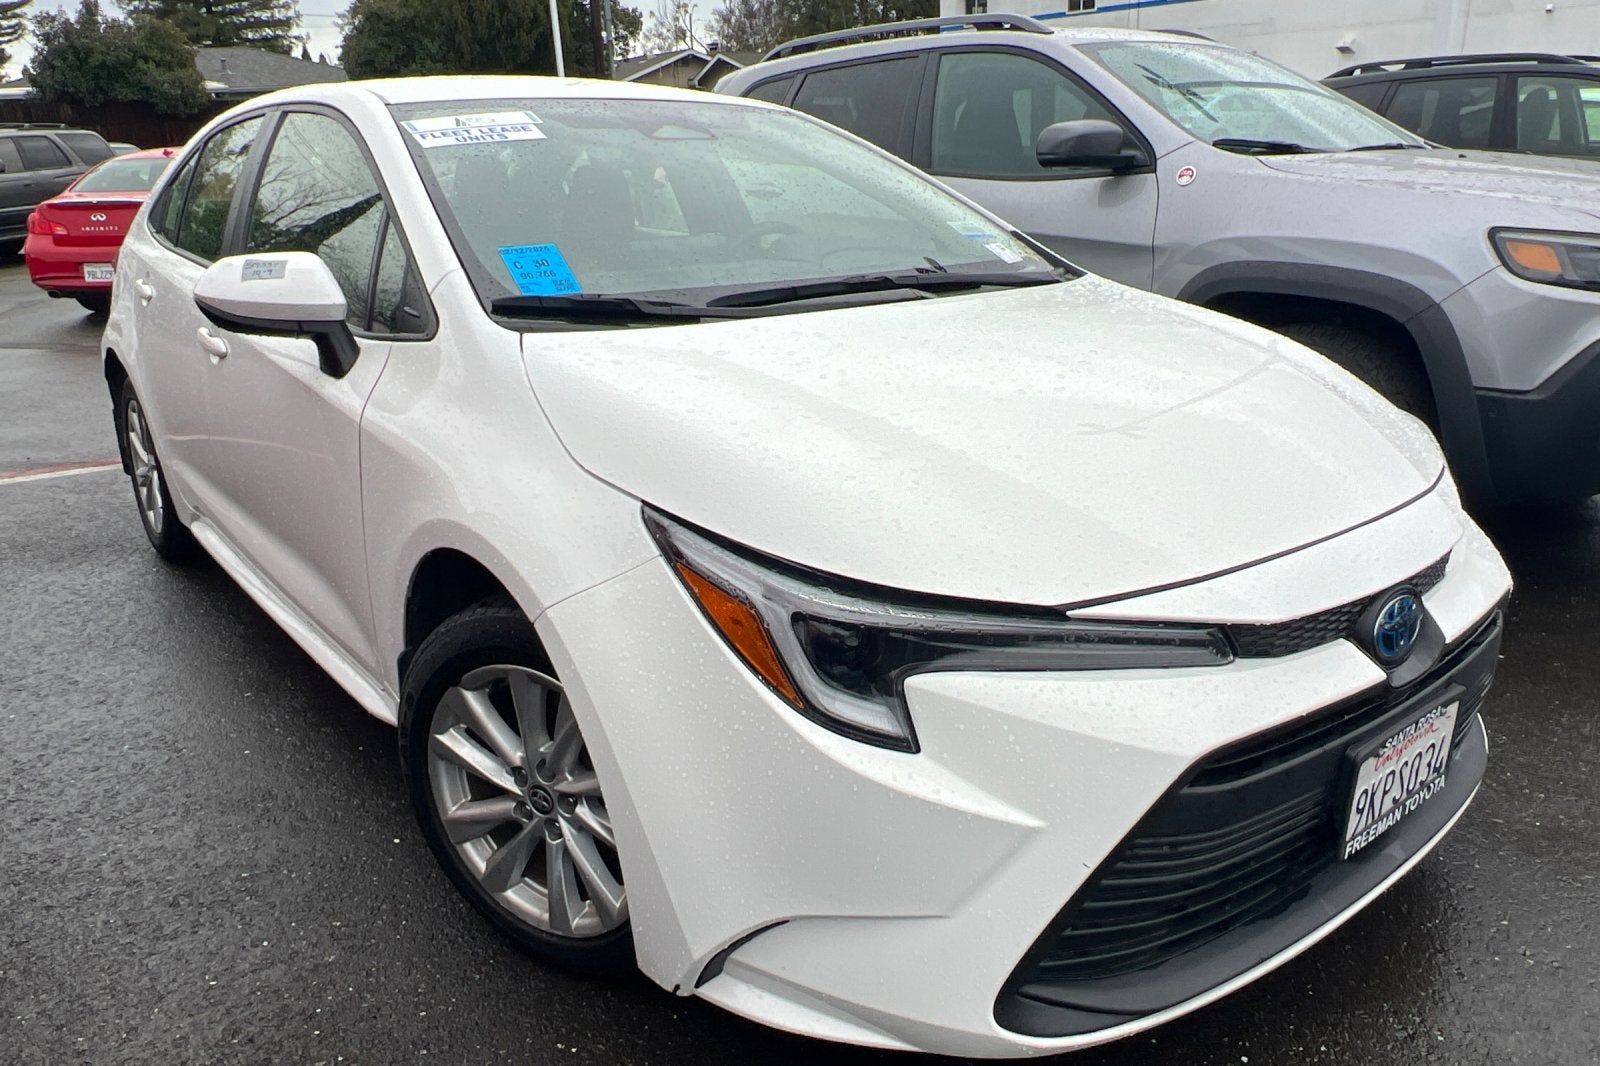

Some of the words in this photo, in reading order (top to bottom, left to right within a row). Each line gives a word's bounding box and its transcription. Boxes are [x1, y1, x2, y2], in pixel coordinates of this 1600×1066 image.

[419, 129, 473, 140] FLEET
[478, 125, 533, 135] LEASE
[456, 134, 508, 143] UNITS
[533, 258, 550, 269] 30
[1385, 723, 1416, 749] SANTA
[1416, 706, 1441, 731] ROSA
[1344, 806, 1402, 860] FREEMAN
[1404, 774, 1446, 815] TOYOTA
